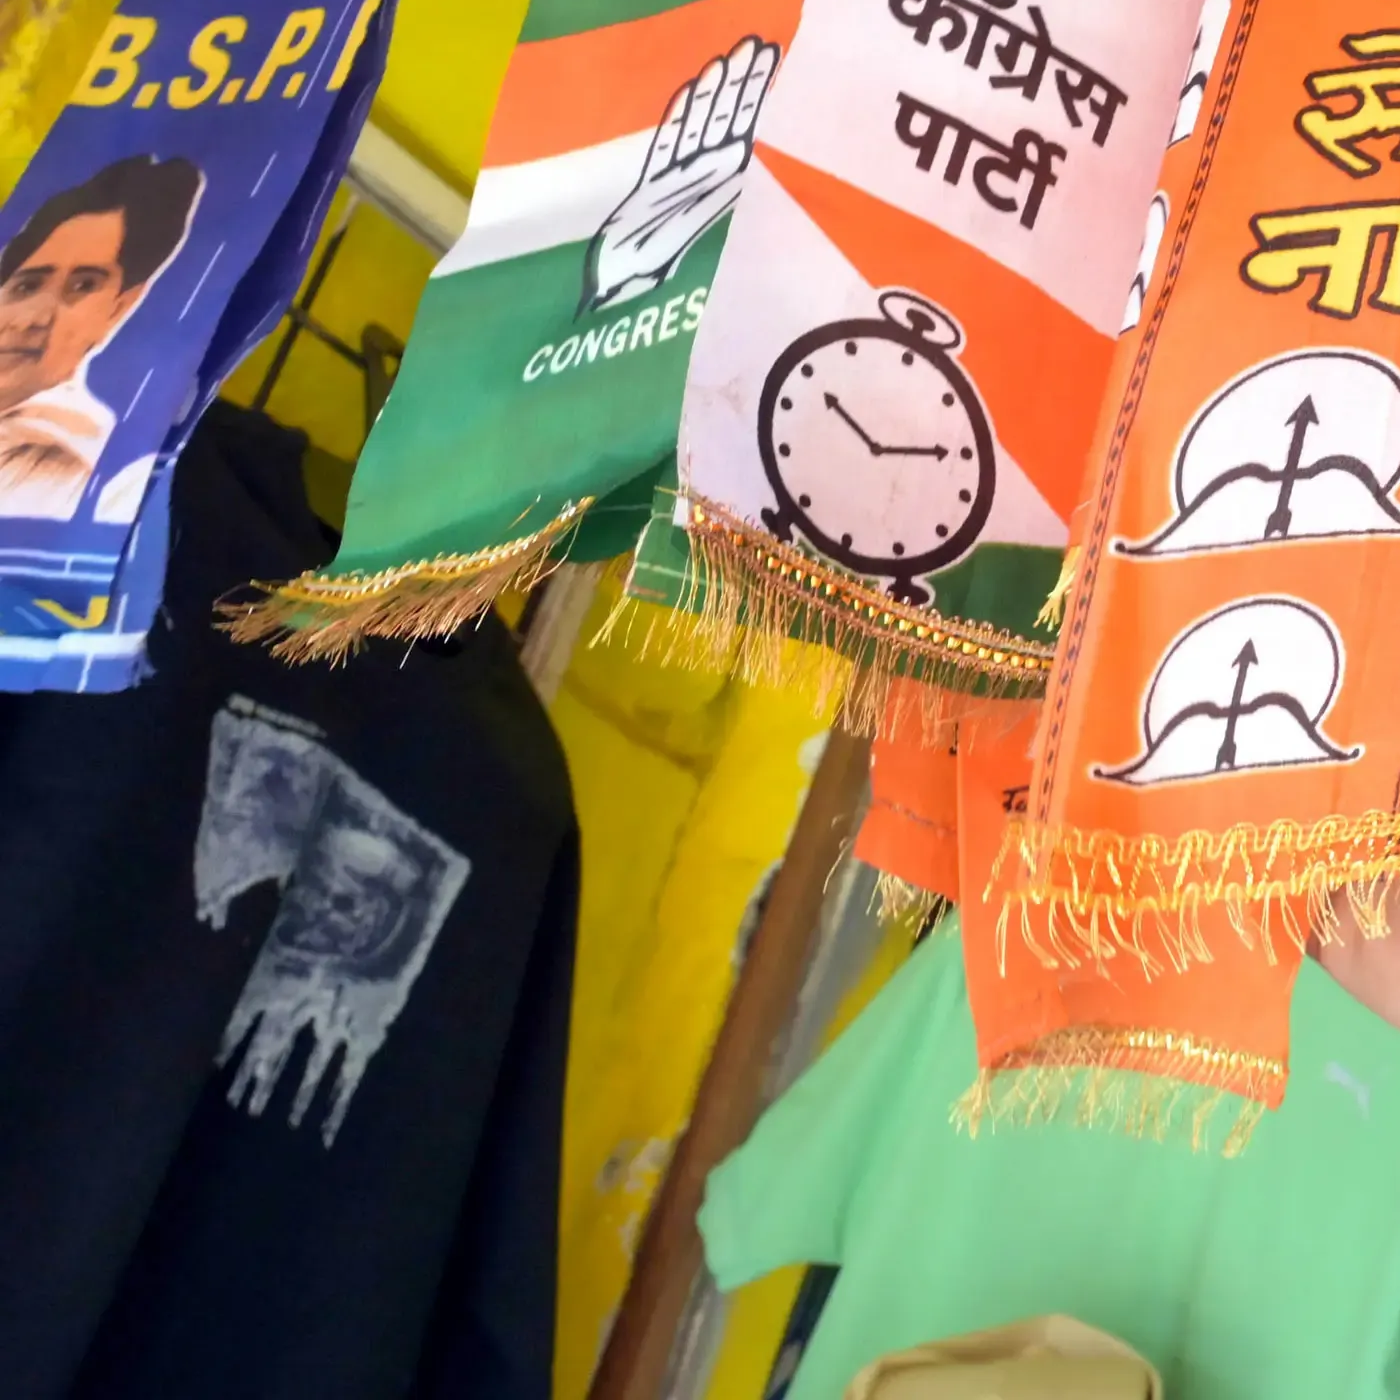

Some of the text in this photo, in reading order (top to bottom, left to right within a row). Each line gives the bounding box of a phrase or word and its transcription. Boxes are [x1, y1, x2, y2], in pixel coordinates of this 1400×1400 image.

[68, 7, 327, 110] B.S.P.
[894, 90, 1068, 231] पार्टी
[522, 285, 709, 383] CONGRES
